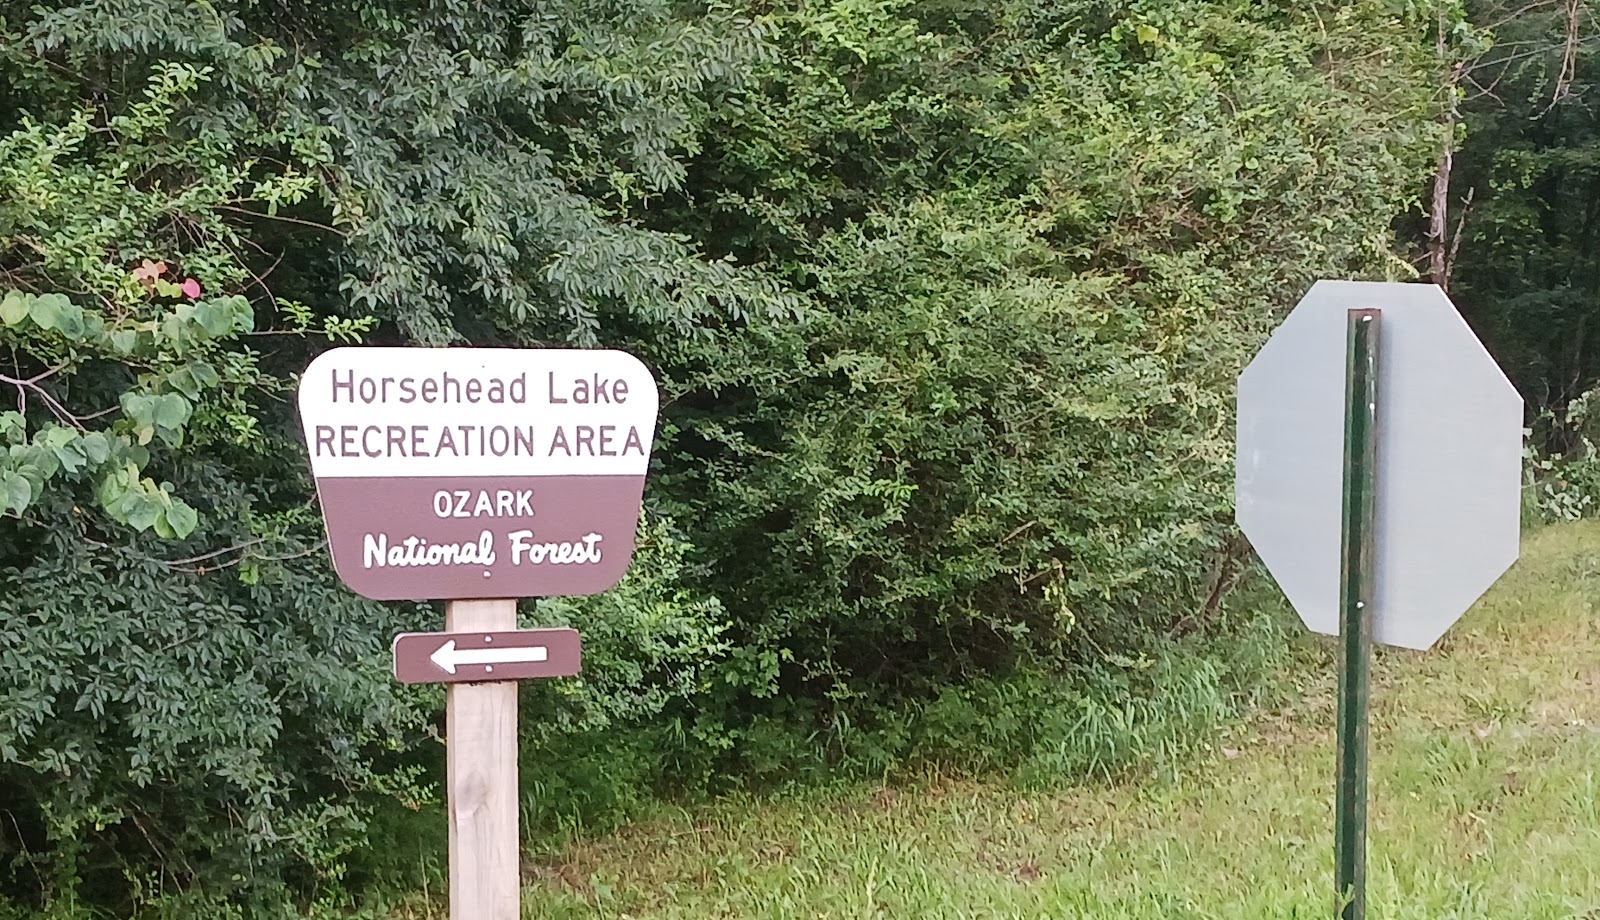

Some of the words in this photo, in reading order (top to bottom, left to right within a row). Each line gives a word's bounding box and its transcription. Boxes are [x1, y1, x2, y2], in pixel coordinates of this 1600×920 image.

[332, 369, 526, 404] Horsehead
[549, 371, 629, 404] Lake
[316, 425, 533, 458] RECREATION
[548, 425, 645, 457] AREA
[433, 490, 535, 518] OZARK
[363, 530, 496, 568] National
[507, 530, 602, 566] Forest
